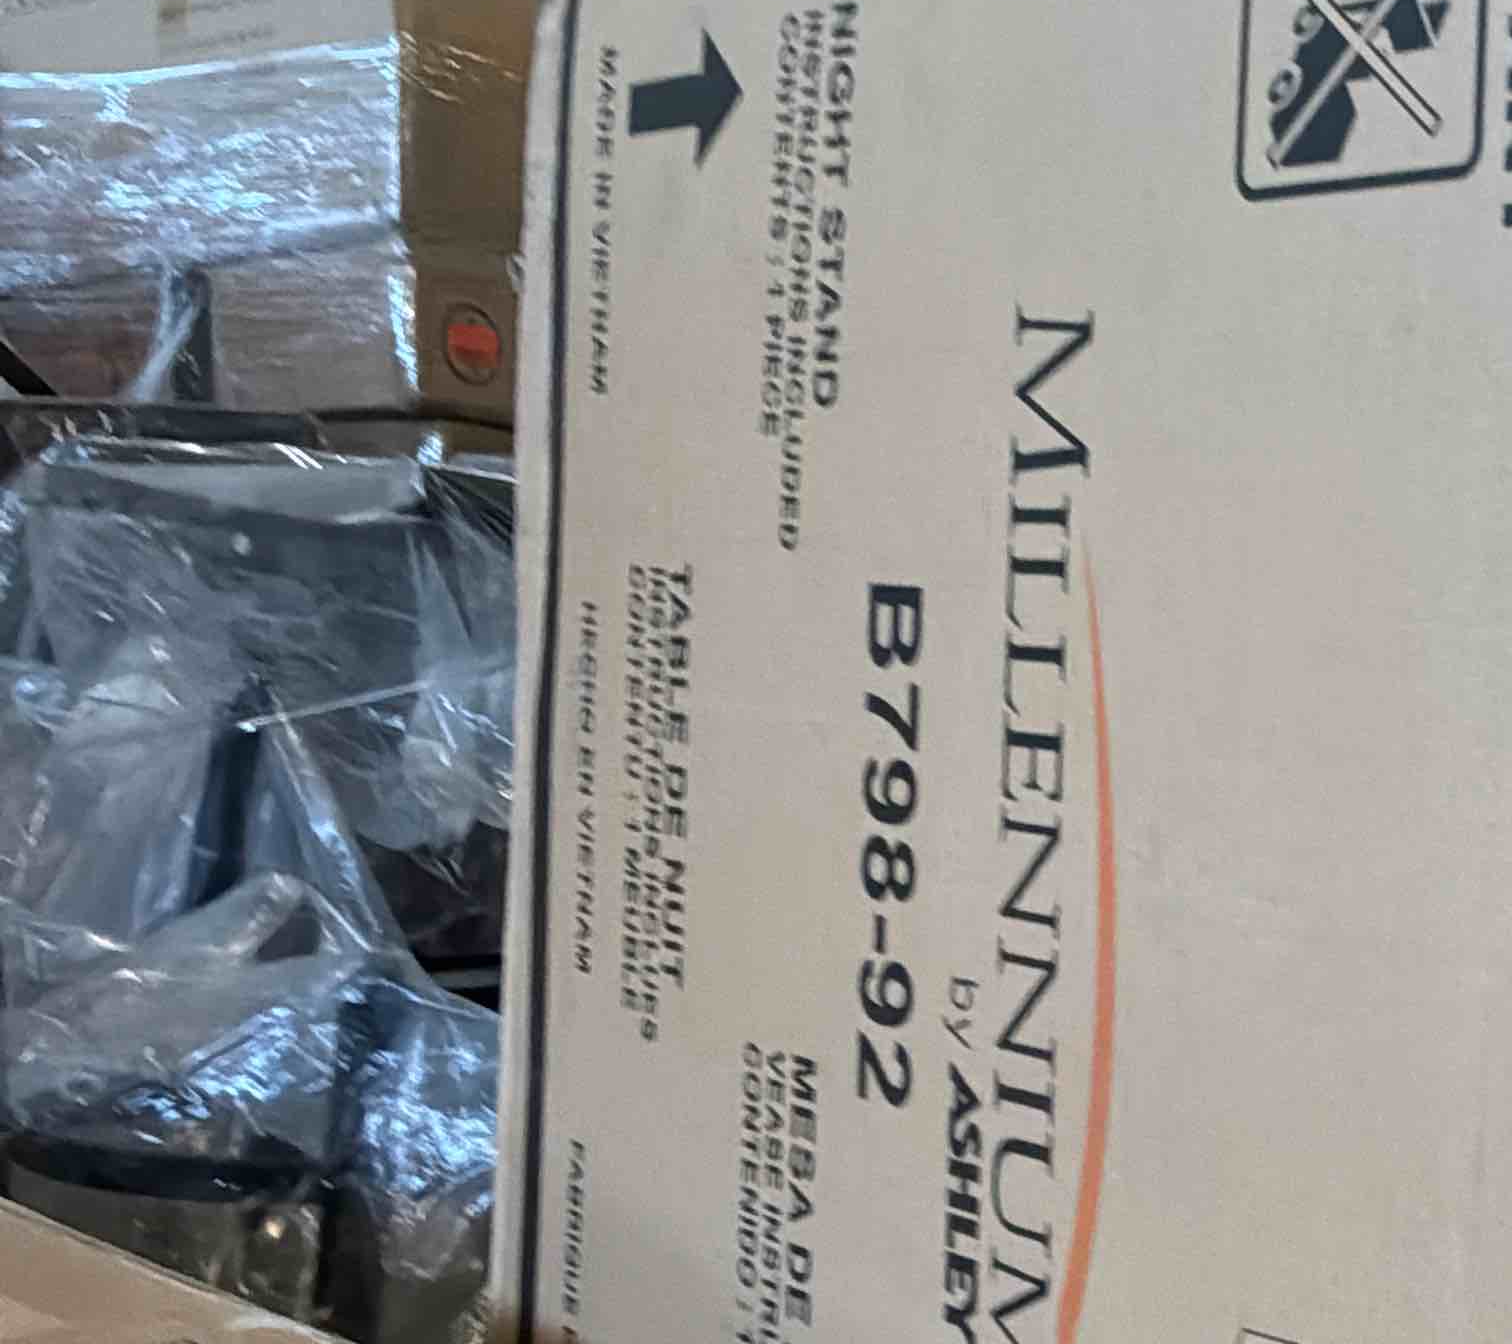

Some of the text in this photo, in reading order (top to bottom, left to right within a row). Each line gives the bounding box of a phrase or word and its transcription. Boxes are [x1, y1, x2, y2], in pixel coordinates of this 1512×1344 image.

[589, 45, 619, 394] MADE IN VIETNAM
[767, 13, 800, 239] CONTENTS
[812, 2, 859, 409] NIGHT STAND
[761, 314, 783, 436] PIECE
[778, 10, 823, 551] INSTRUCTIONS INCLUDED
[625, 564, 647, 778] CONTENTU
[662, 564, 693, 986] TABLE DE NUIT
[574, 809, 595, 974] VIETNAM
[621, 849, 641, 1011] MEUBLE
[851, 581, 926, 1109] B798-92
[764, 1051, 786, 1190] VEASE
[939, 977, 984, 1053] by
[736, 1042, 762, 1287] CONTENIDO
[787, 1054, 817, 1222] MESA
[787, 1242, 813, 1326] DE
